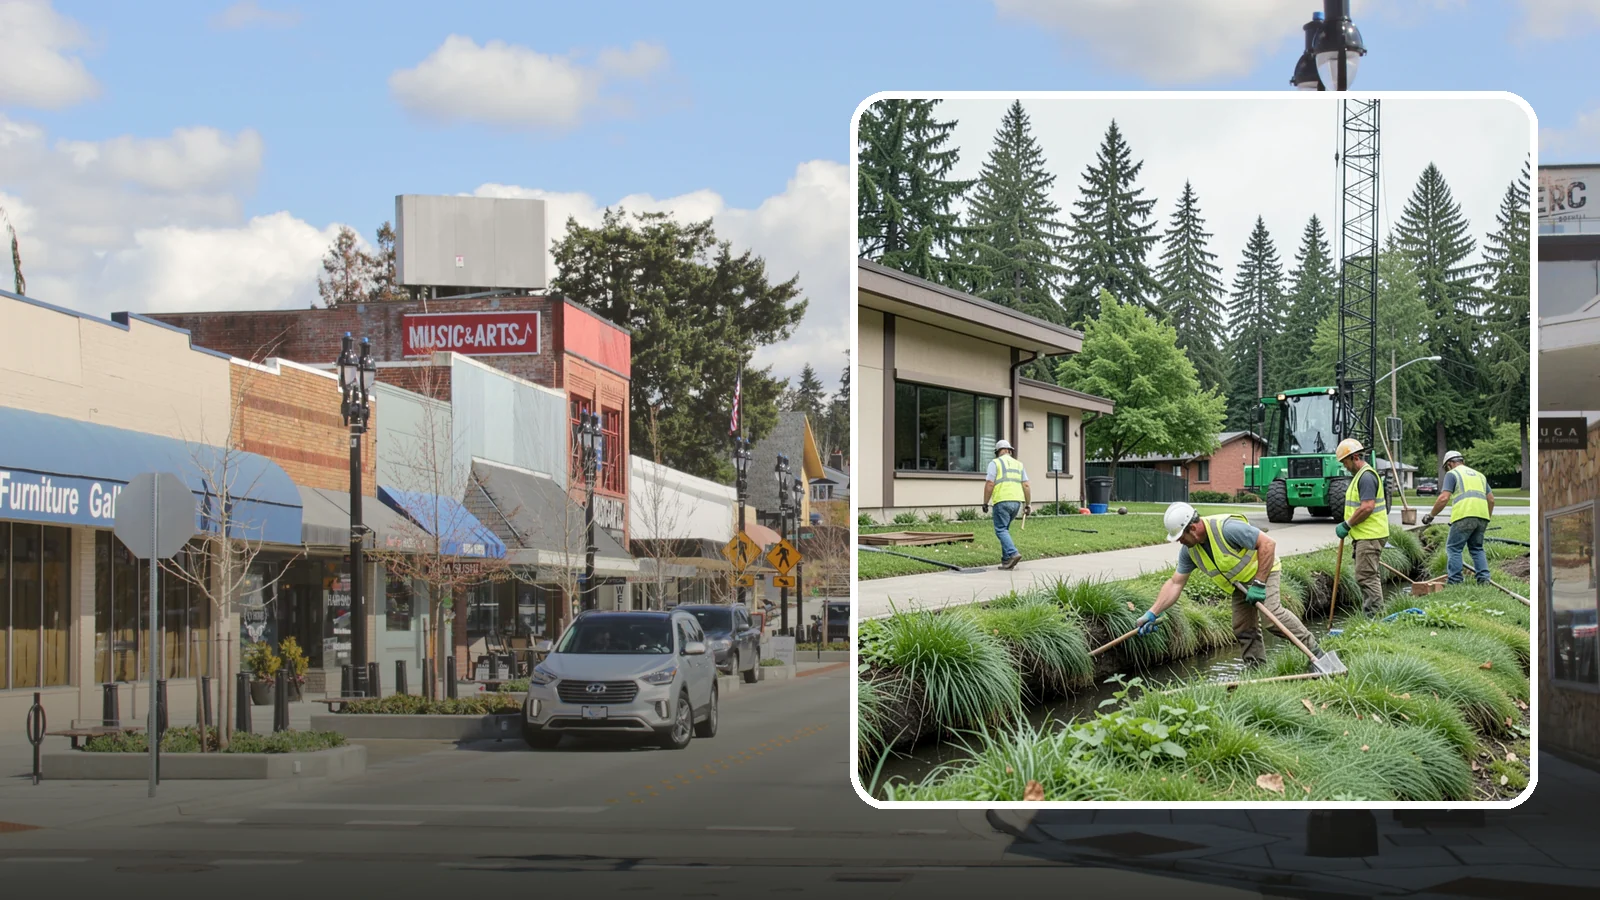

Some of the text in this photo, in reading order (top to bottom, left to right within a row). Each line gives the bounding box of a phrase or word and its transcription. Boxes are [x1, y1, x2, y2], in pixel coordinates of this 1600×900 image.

[408, 322, 519, 349] MUSIC&ARTS
[1540, 427, 1577, 437] UGA
[0, 471, 122, 519] Furniture Gal
[453, 563, 479, 574] SUSHI
